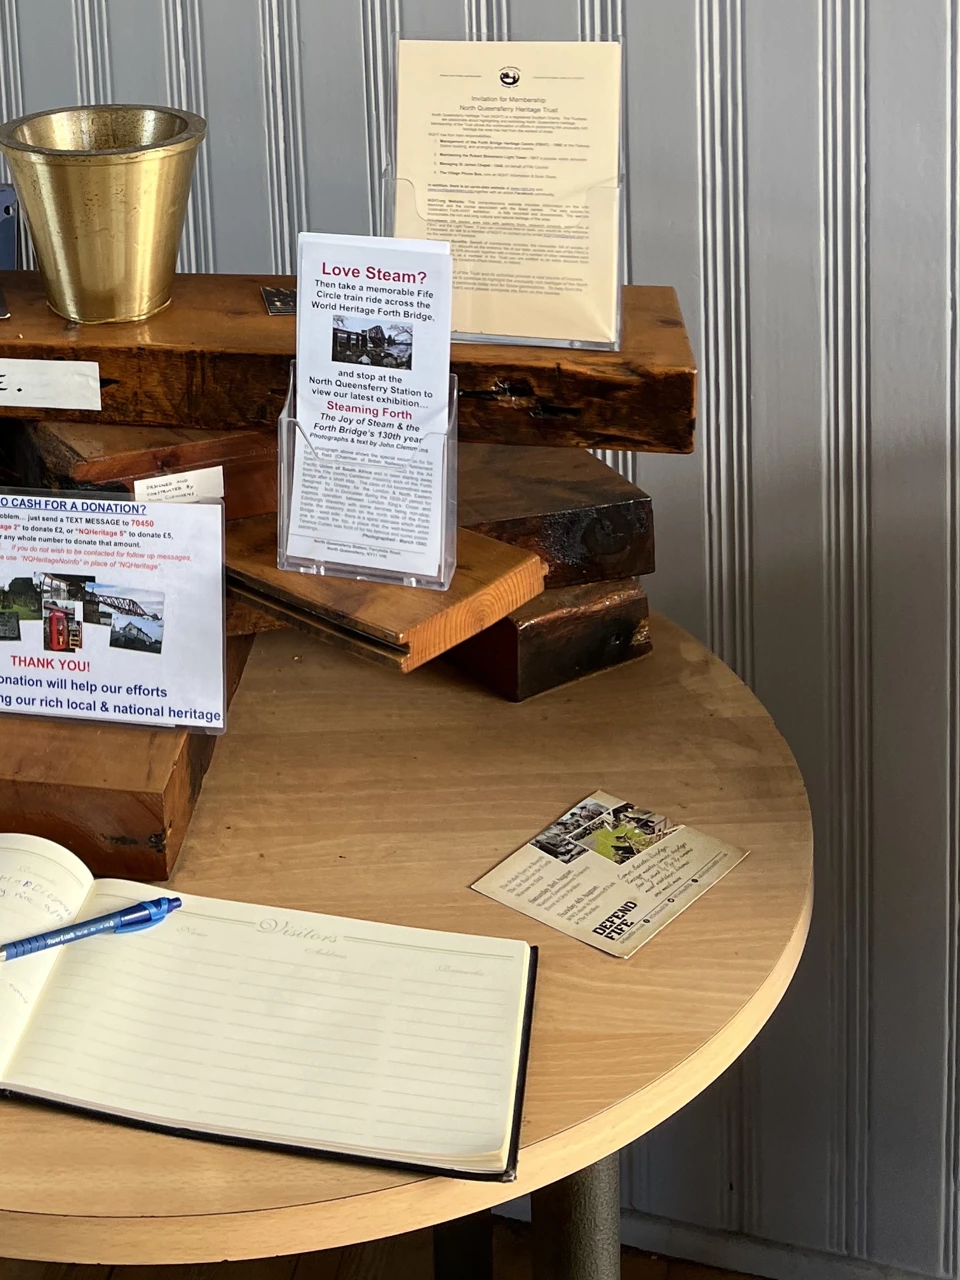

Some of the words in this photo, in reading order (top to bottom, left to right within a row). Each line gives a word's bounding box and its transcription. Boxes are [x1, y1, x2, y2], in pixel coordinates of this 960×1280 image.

[322, 262, 359, 277] Love
[366, 266, 426, 283] Steam?
[315, 279, 335, 287] Then
[338, 282, 355, 290] take
[366, 286, 414, 296] memorable
[417, 289, 433, 298] Fife
[316, 290, 341, 299] Circle
[343, 293, 362, 301] train
[384, 299, 413, 307] across
[311, 301, 336, 309] World
[339, 303, 374, 315] Heritage
[377, 307, 400, 316] Forth
[403, 310, 433, 321] Bridge.
[309, 376, 332, 385] North
[335, 379, 387, 393] Queensferry
[390, 386, 421, 396] Station
[356, 372, 375, 381] stop
[388, 375, 402, 383] the
[350, 392, 374, 403] latest
[327, 400, 378, 417] Steaming
[382, 407, 411, 419] Forth
[321, 412, 335, 421] The
[338, 415, 353, 425] Joy
[367, 418, 394, 428] Steam
[313, 422, 336, 431] Forth
[338, 425, 374, 437] Bridge's
[378, 431, 400, 440] 130th
[11, 497, 40, 509] CASH
[44, 499, 66, 510] FOR
[70, 501, 77, 511] A
[81, 502, 145, 514] DONATION?
[85, 517, 119, 525] MESSAGE
[10, 655, 54, 669] THANK
[58, 659, 89, 671] YOU!
[46, 678, 66, 689] will
[71, 679, 96, 694] help
[101, 684, 121, 693] our
[126, 684, 166, 697] efforts
[15, 696, 35, 705] our
[40, 696, 62, 708] rich
[67, 698, 95, 711] local
[100, 701, 108, 711] &
[113, 704, 163, 716] national
[592, 901, 638, 936] DEFEND
[256, 917, 341, 945] Visitors
[604, 918, 634, 941] FIFE
